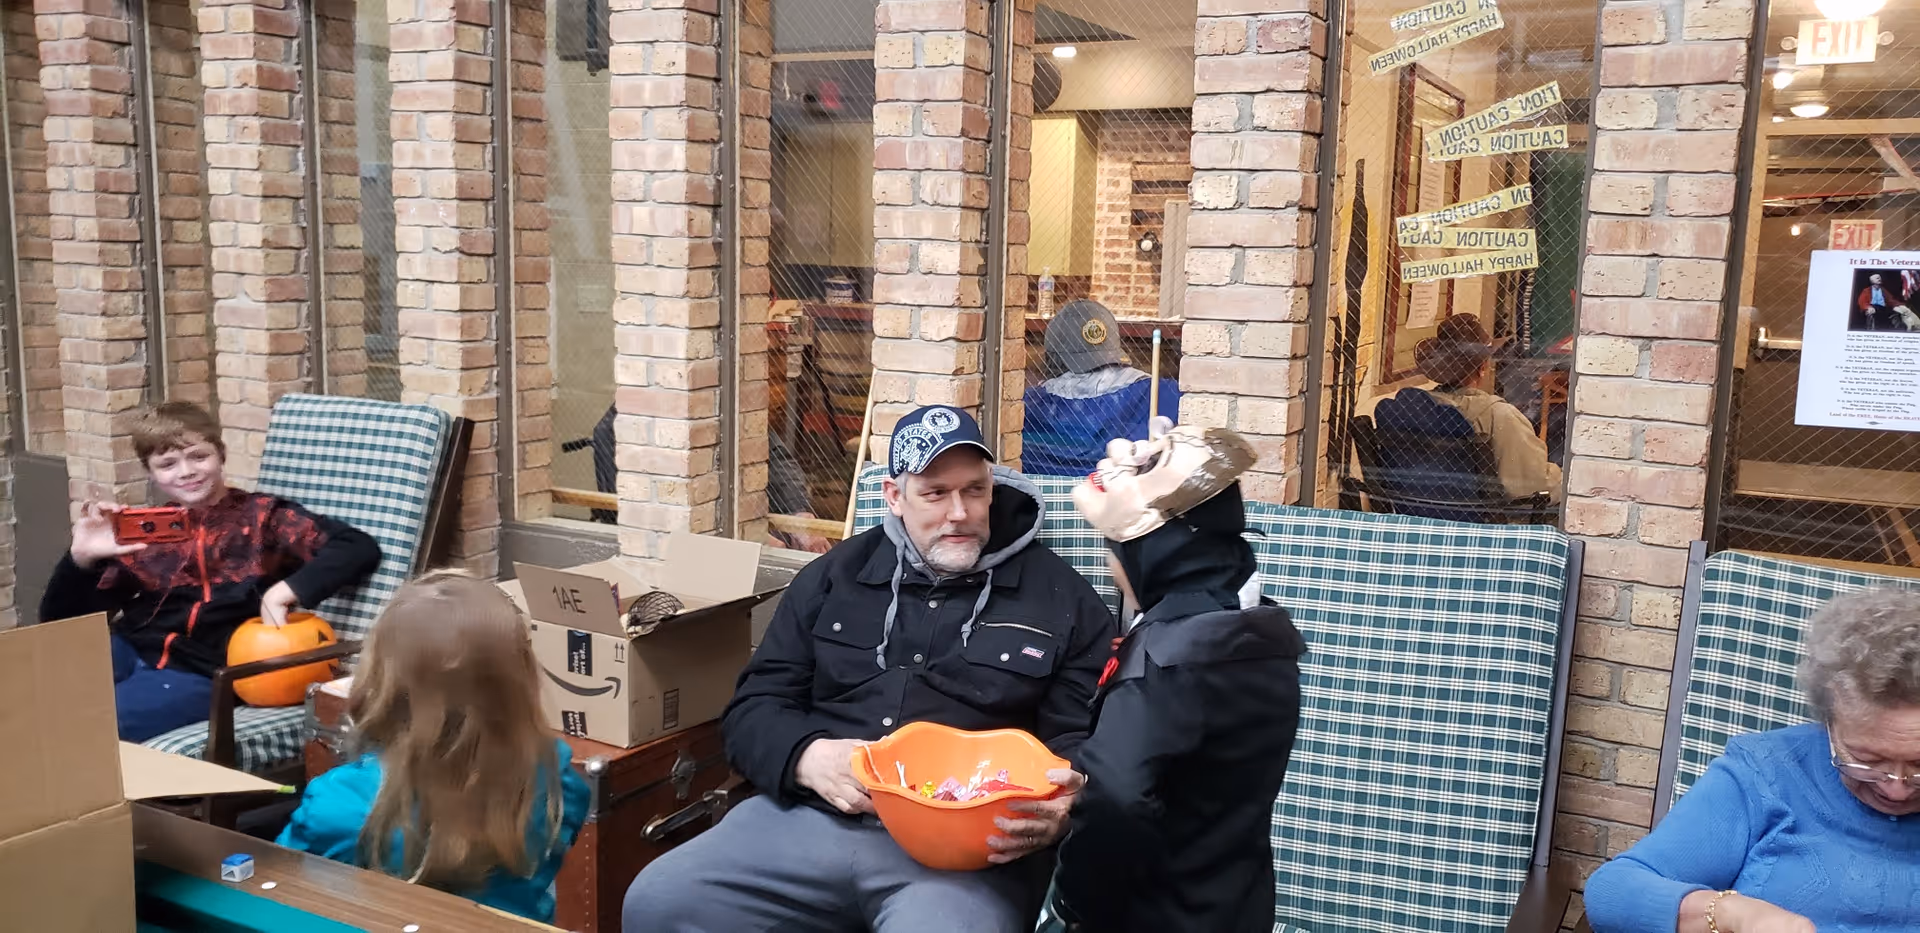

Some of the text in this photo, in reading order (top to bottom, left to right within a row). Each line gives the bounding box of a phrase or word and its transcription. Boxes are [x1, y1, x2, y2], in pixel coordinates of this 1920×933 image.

[1811, 22, 1867, 57] EXIT
[1833, 223, 1877, 249] EXIT
[1869, 258, 1888, 266] The
